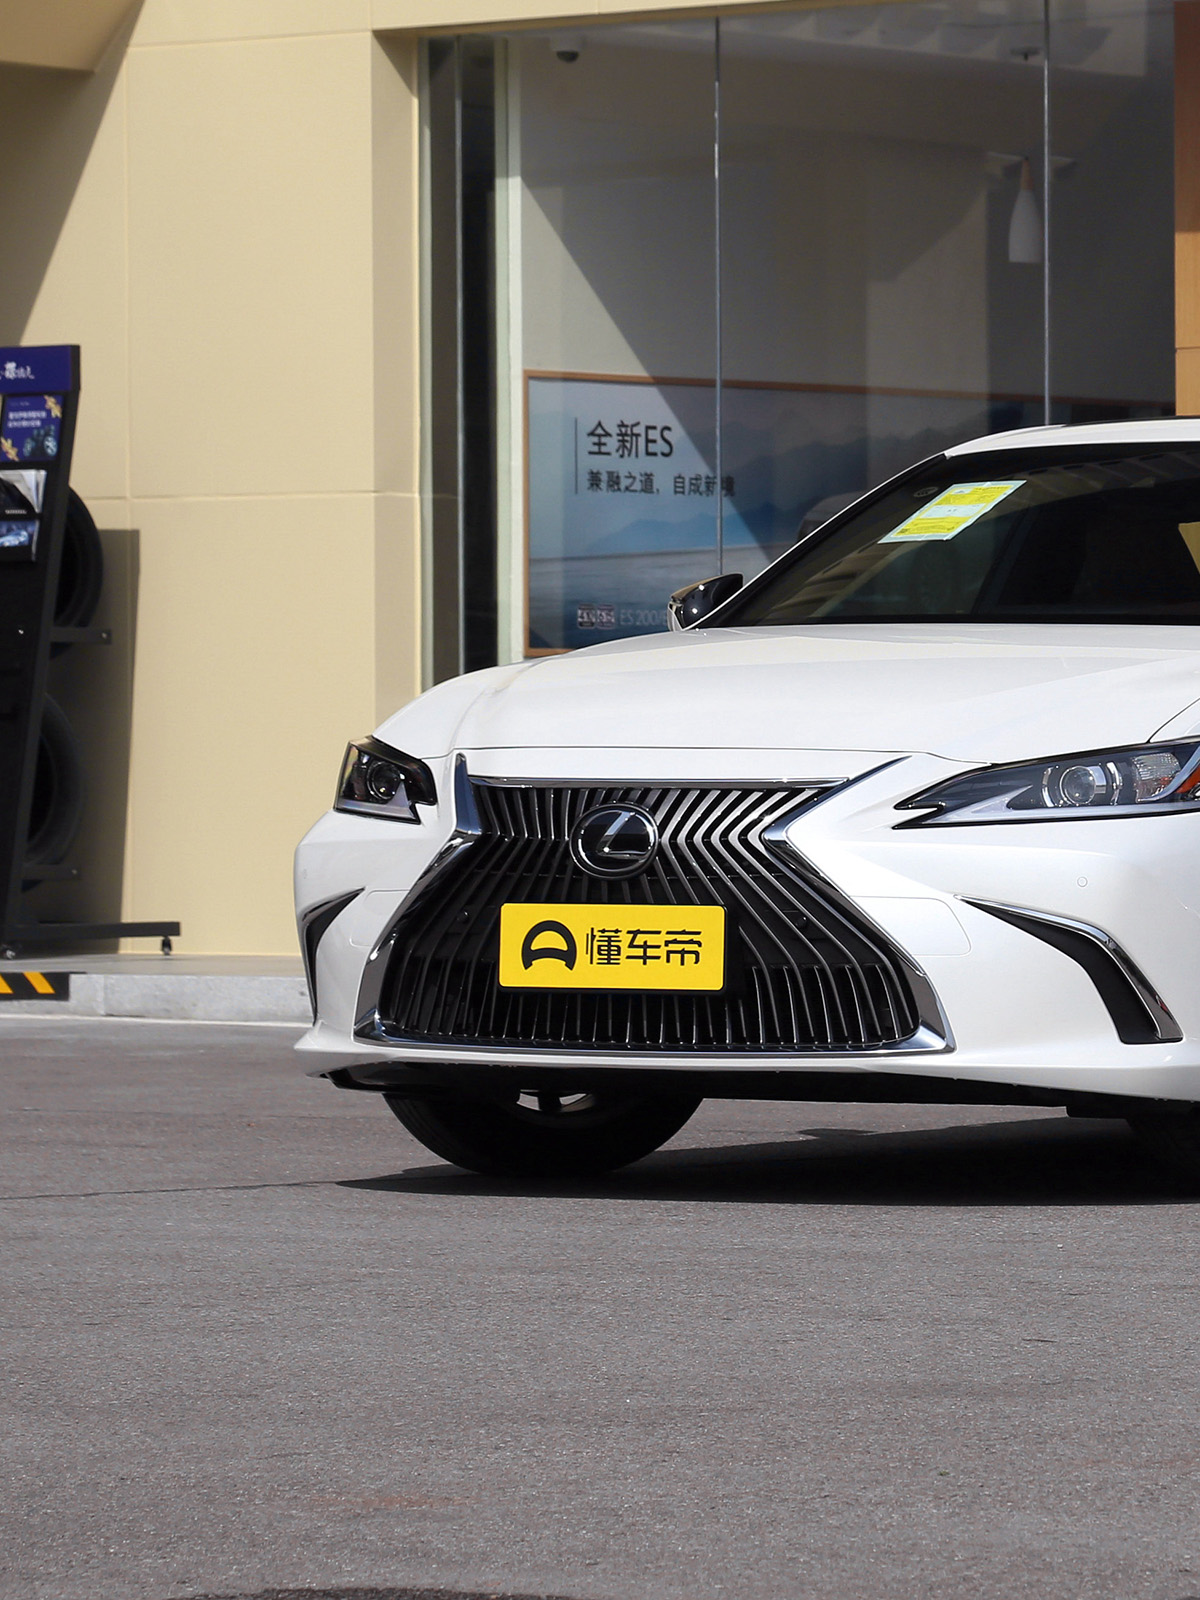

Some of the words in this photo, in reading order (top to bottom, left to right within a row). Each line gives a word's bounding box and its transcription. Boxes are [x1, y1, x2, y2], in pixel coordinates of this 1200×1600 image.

[586, 420, 674, 459] 全新ES
[586, 927, 702, 966] 懂车帝
